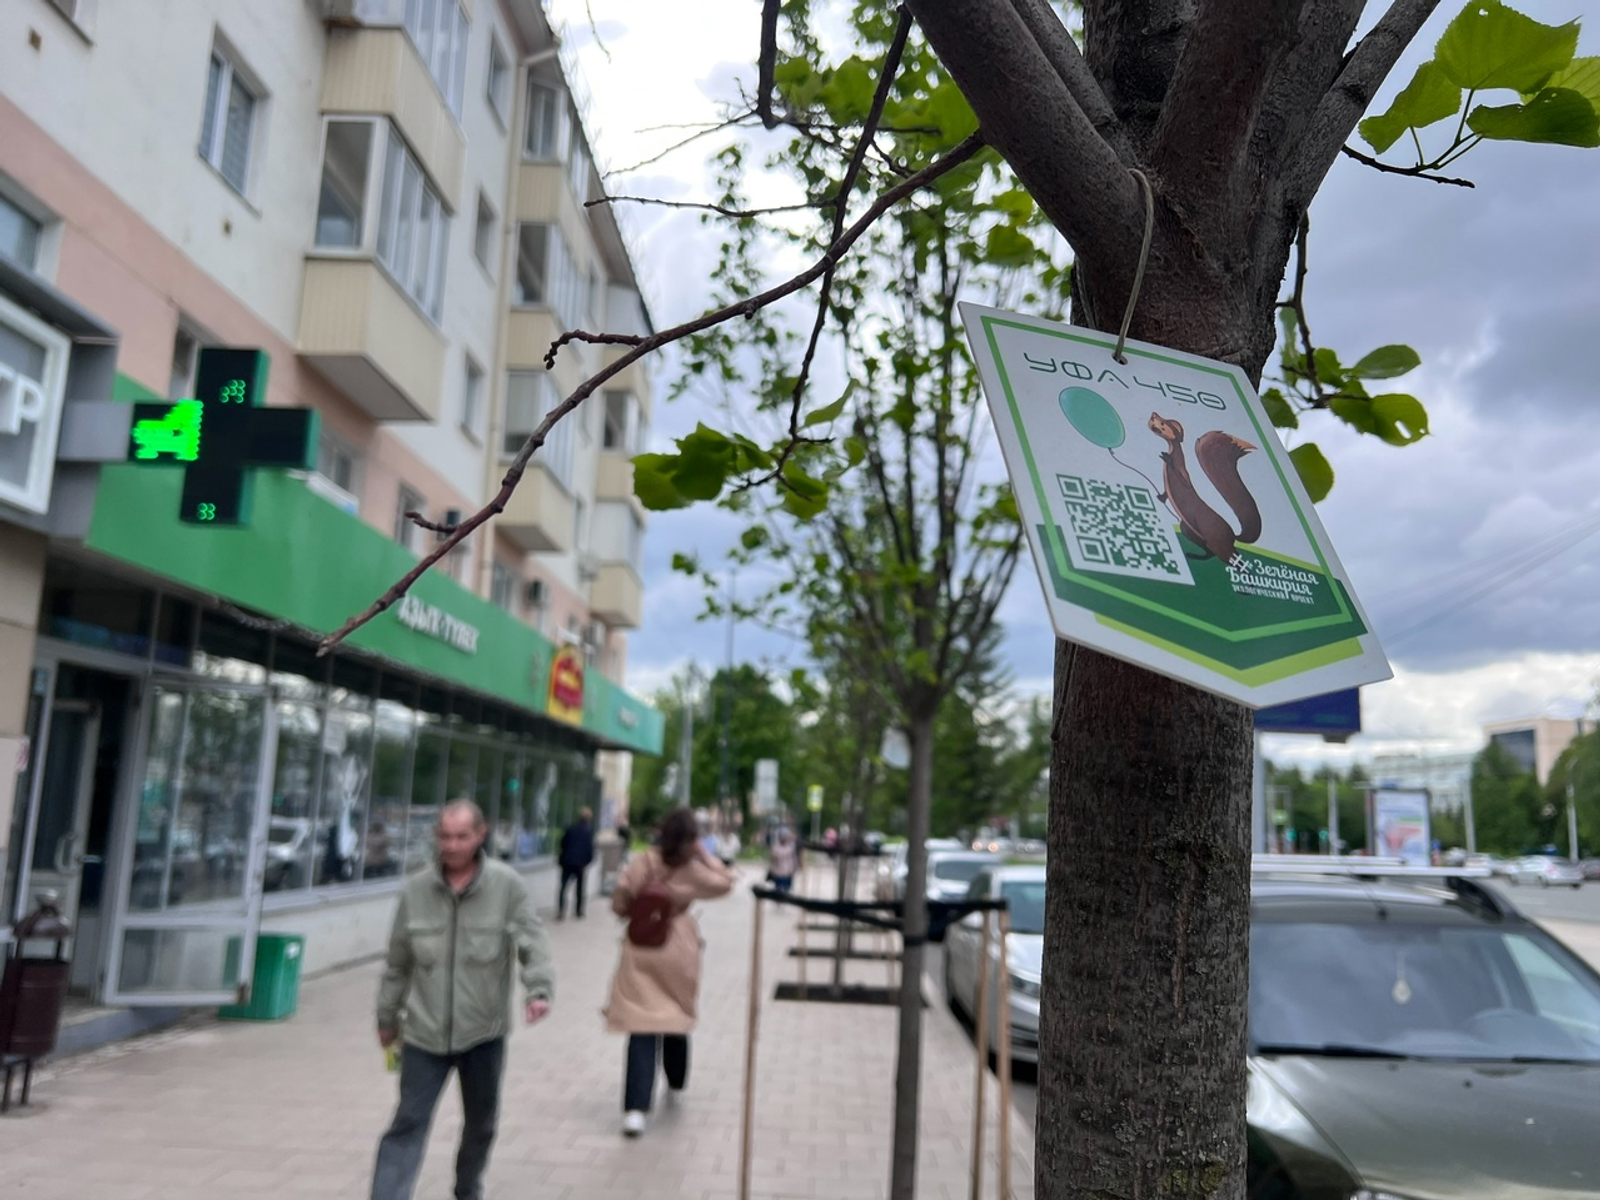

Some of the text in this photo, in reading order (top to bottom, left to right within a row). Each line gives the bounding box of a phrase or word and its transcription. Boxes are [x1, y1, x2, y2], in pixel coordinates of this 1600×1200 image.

[1023, 352, 1227, 411] УФА 450
[1225, 566, 1313, 599] Башкирия
